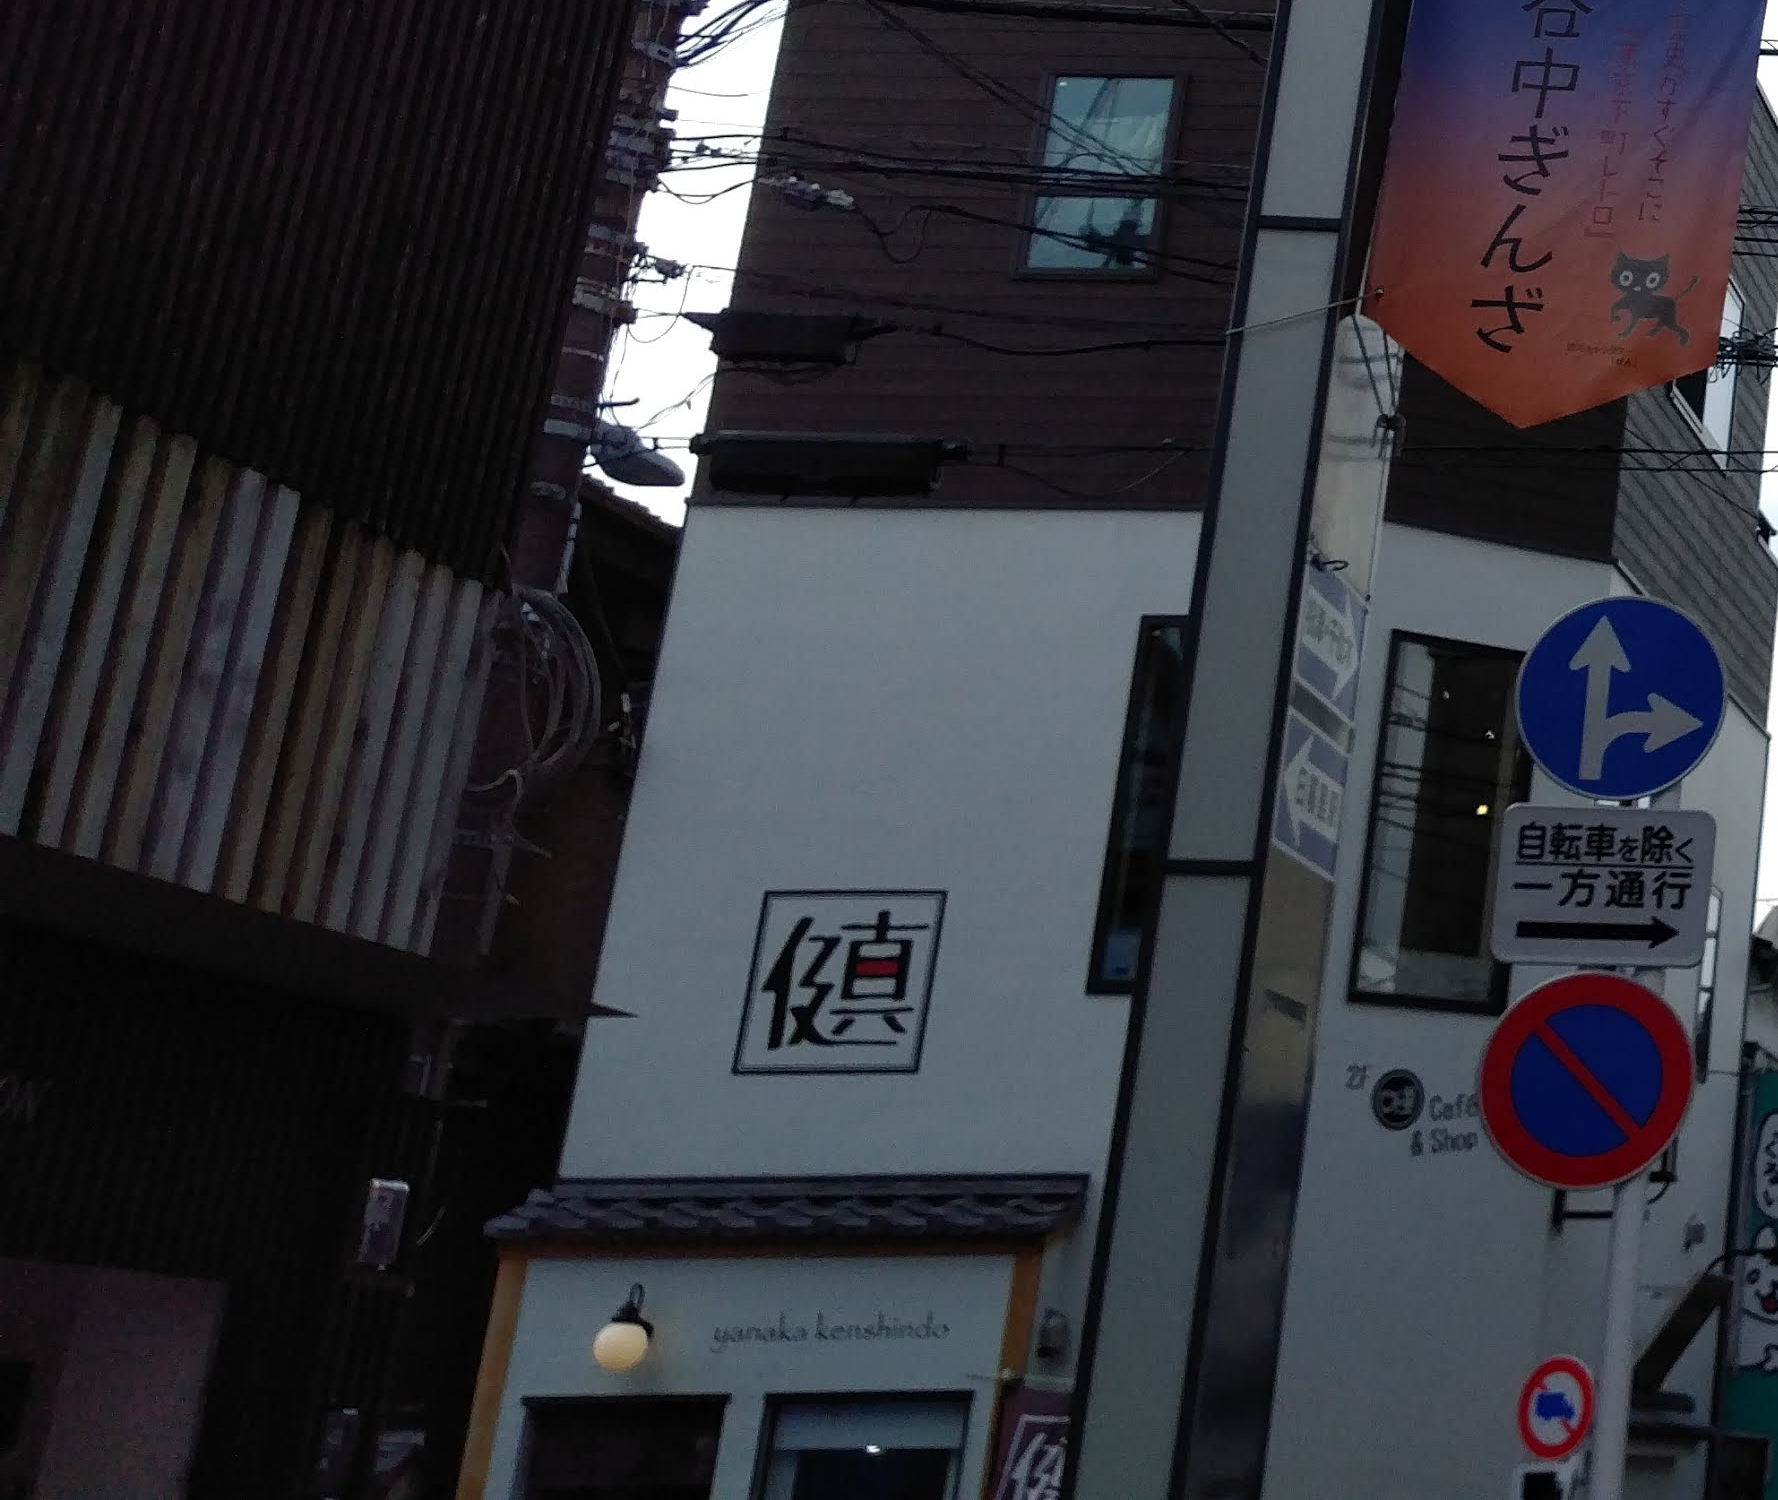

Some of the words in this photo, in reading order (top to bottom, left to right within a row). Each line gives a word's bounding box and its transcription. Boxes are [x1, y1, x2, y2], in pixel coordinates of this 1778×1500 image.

[1516, 821, 1694, 864] 自転車を除く
[1512, 869, 1692, 910] 一方通行
[1430, 1127, 1479, 1154] Shop
[710, 1312, 806, 1352] yanaka
[815, 1311, 951, 1342] kenshindo
